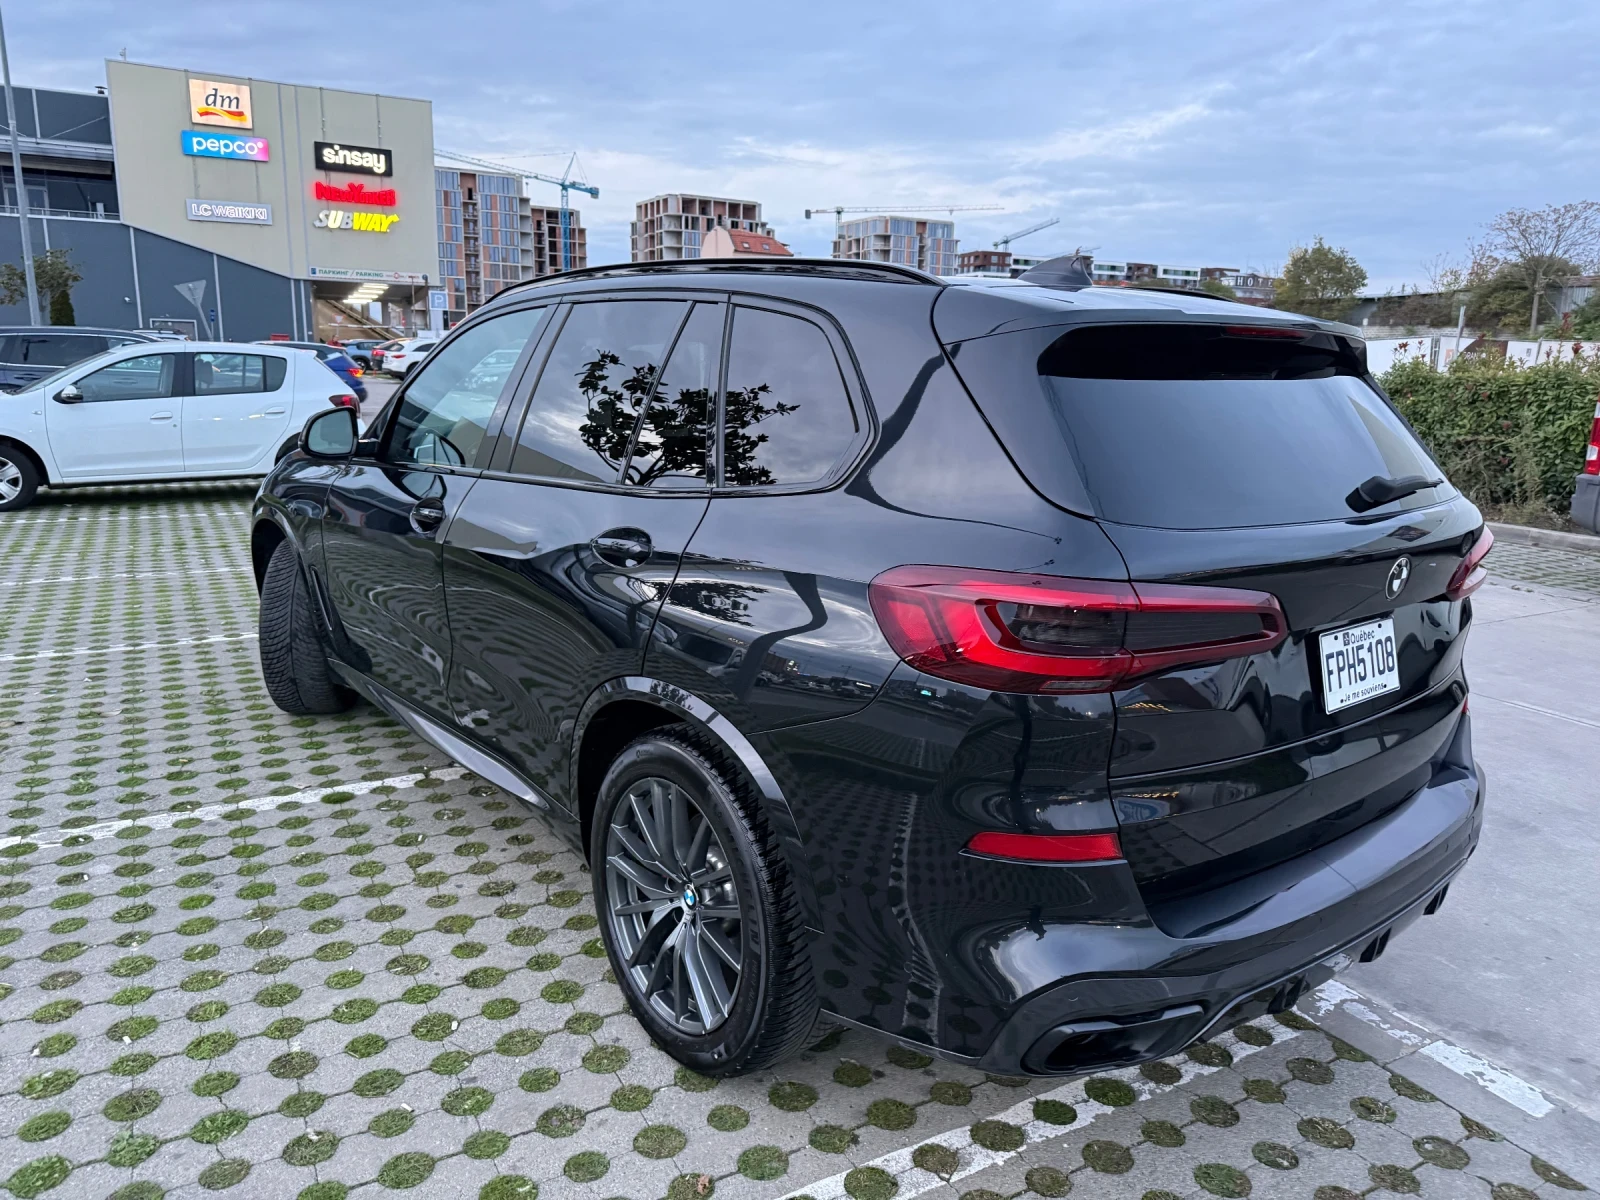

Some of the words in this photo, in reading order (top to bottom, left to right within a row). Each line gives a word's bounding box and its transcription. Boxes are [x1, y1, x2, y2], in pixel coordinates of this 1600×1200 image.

[205, 88, 240, 109] dm
[192, 136, 259, 155] pepco
[322, 144, 386, 174] sinsay
[191, 203, 212, 217] LC
[313, 209, 400, 233] SUBWAY
[434, 295, 443, 306] P
[1350, 630, 1375, 644] Québec
[1325, 635, 1395, 693] FPH5108
[1361, 683, 1384, 697] souviens
